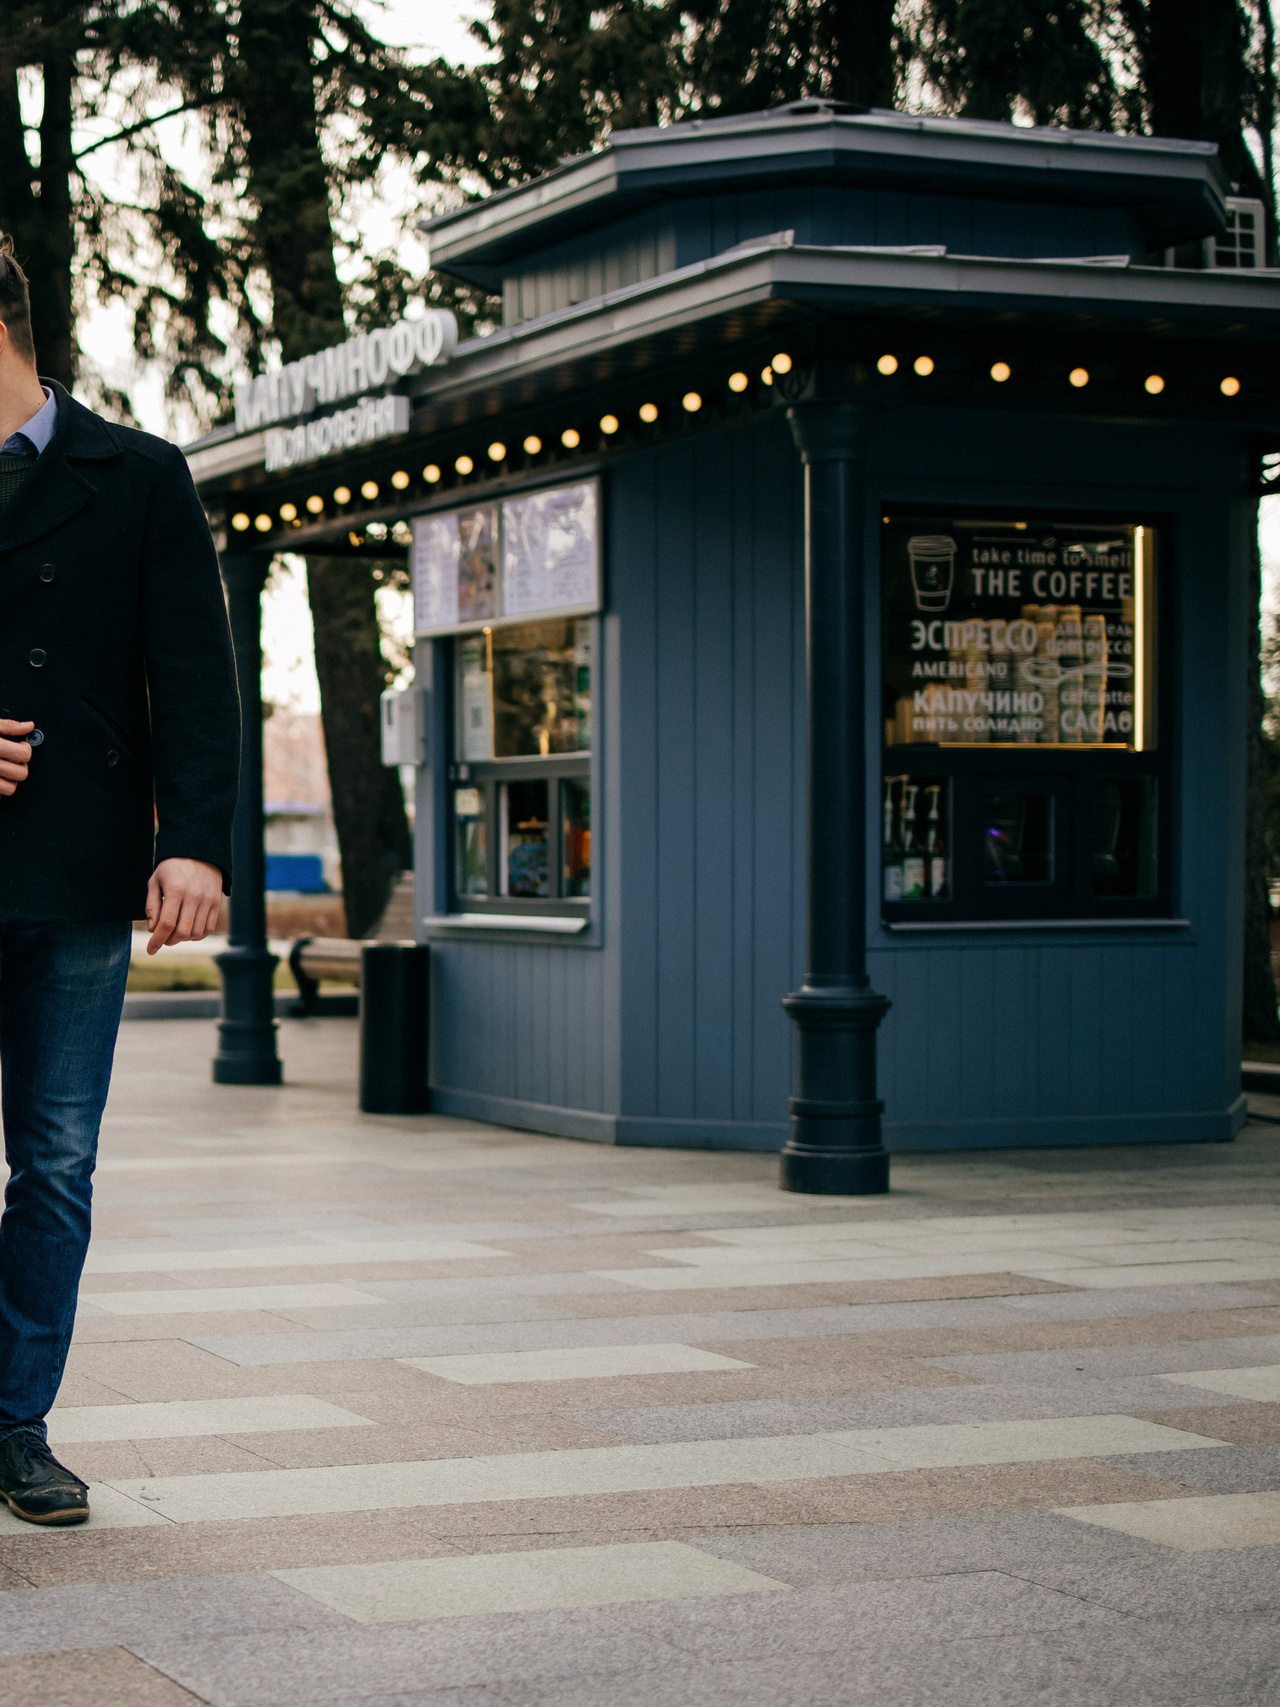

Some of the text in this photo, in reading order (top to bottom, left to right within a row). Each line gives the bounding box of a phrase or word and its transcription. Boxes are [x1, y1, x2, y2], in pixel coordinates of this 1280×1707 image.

[972, 547, 1010, 564] take
[1017, 547, 1057, 566] time
[971, 568, 1132, 600] THE COFFEE
[911, 620, 1038, 651] ЭСПРЕССО
[913, 690, 1045, 715] КАПУЧИНО
